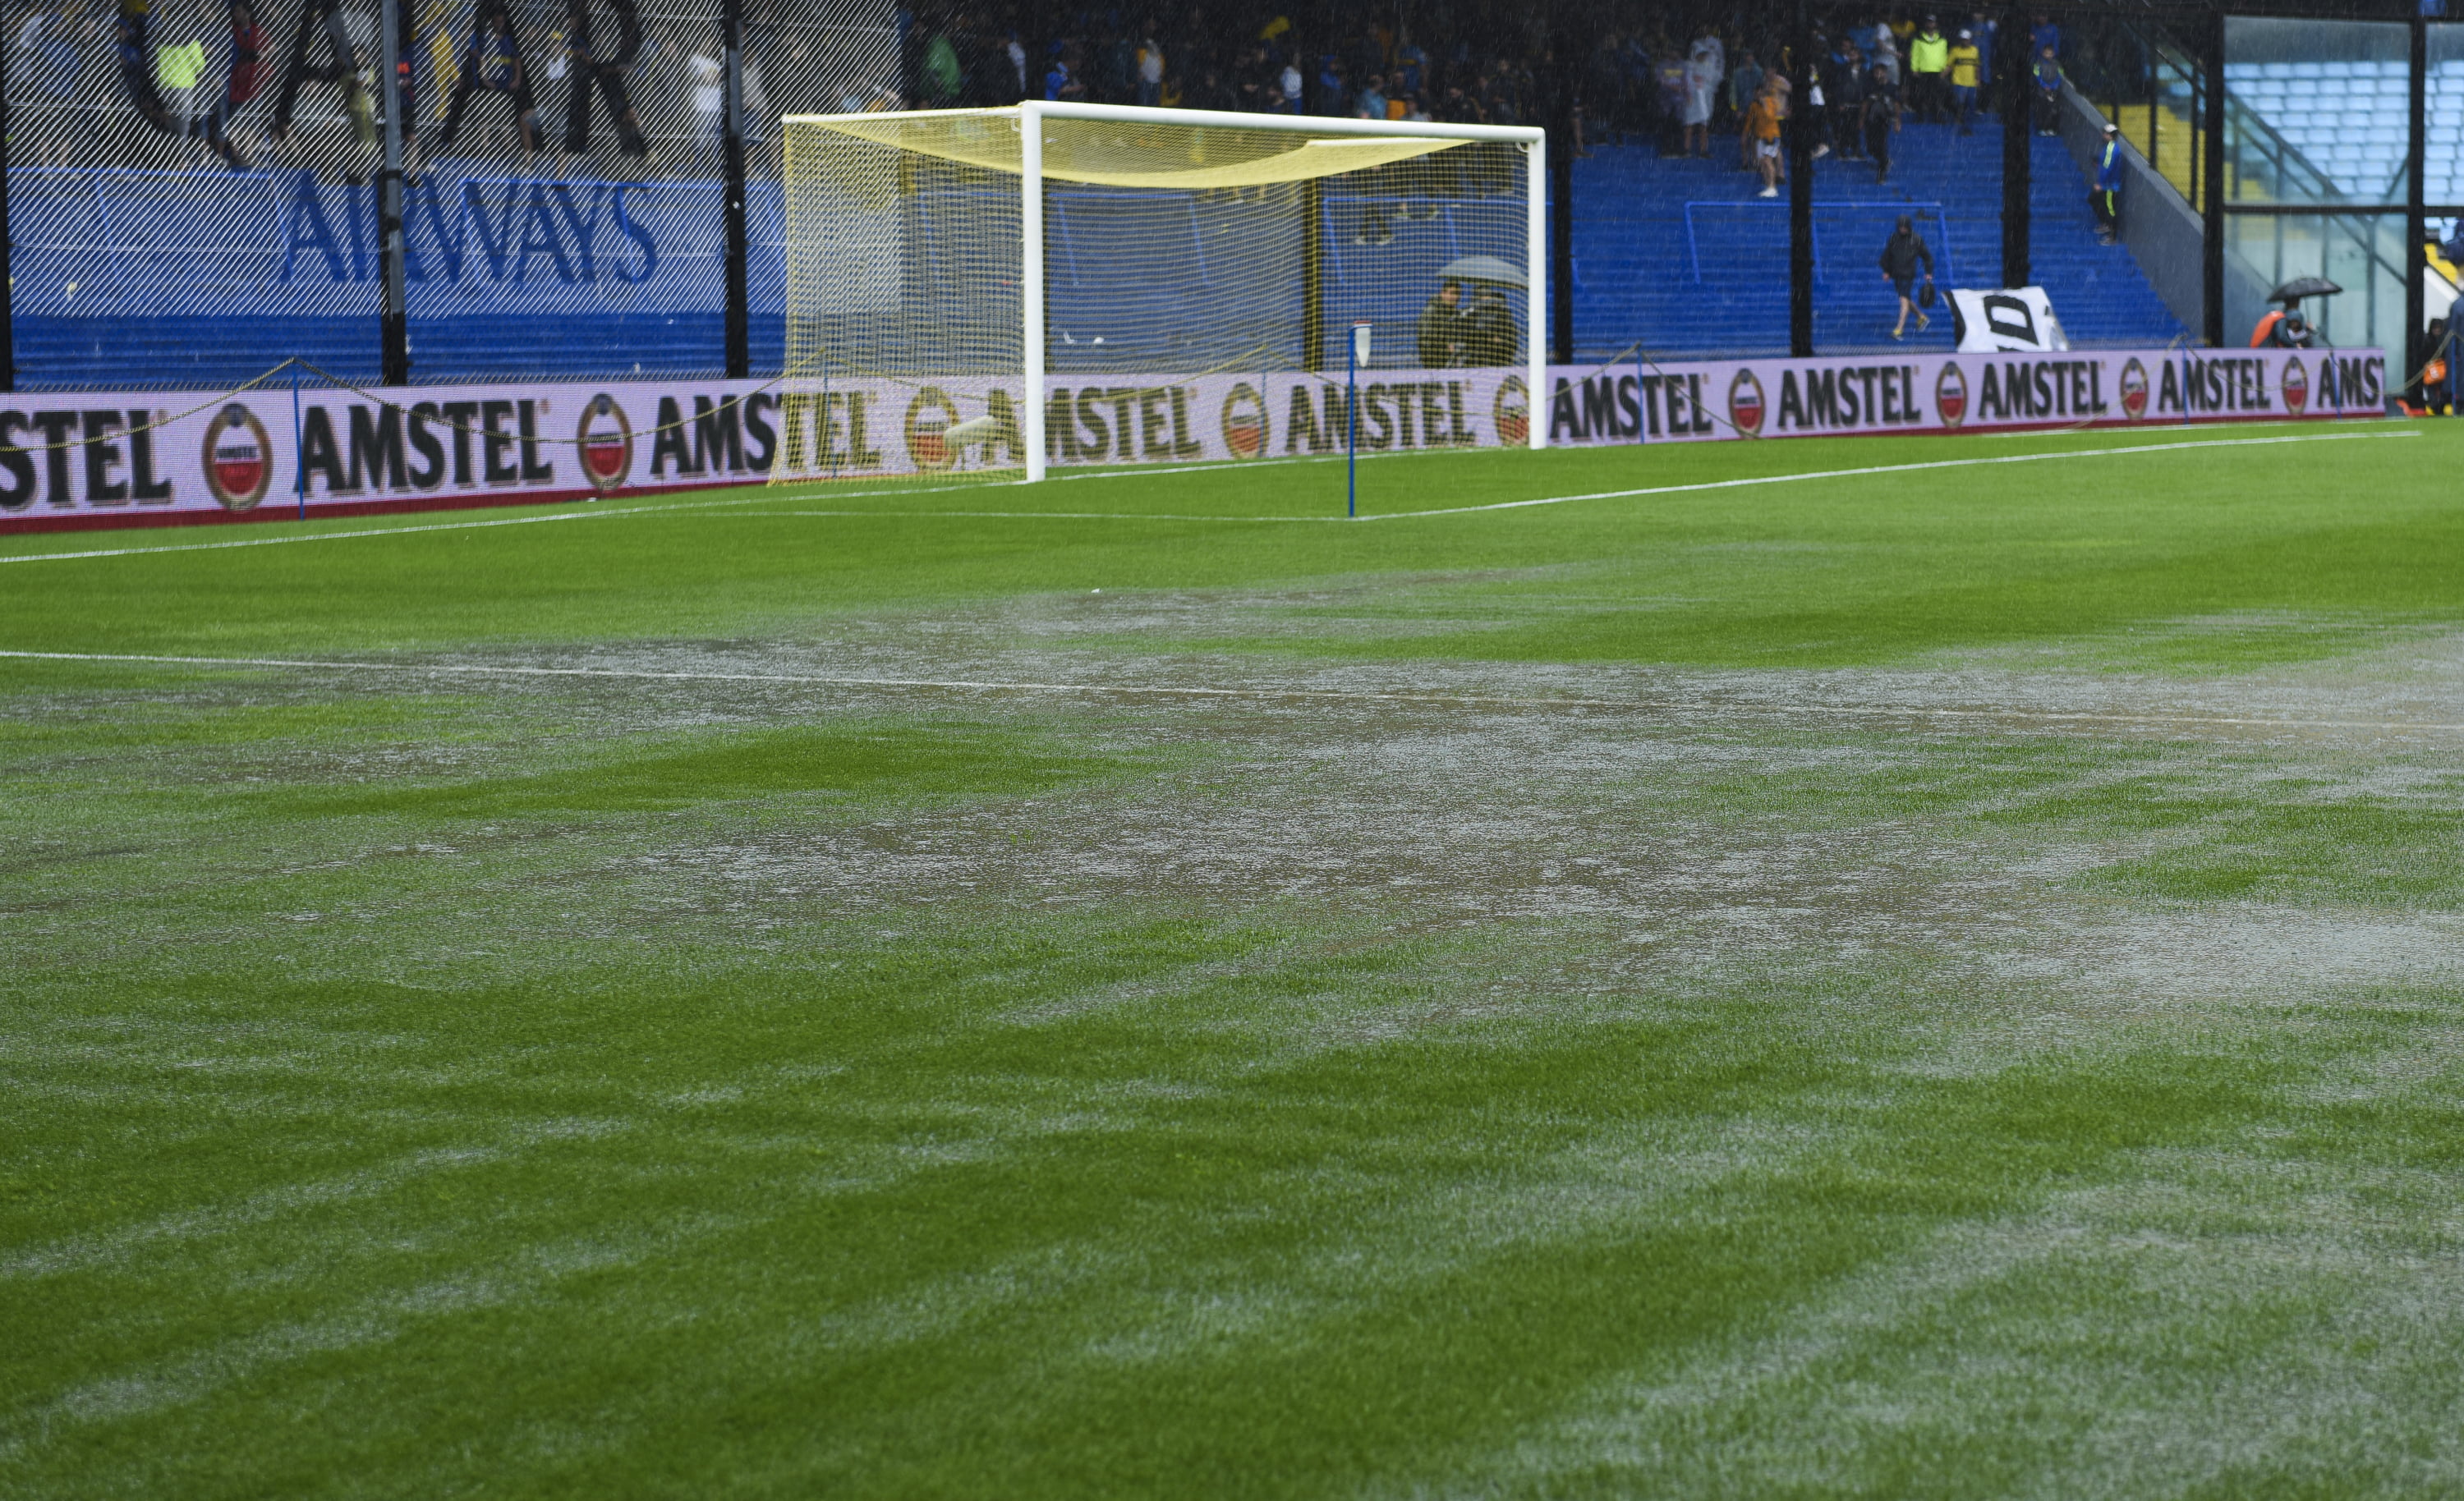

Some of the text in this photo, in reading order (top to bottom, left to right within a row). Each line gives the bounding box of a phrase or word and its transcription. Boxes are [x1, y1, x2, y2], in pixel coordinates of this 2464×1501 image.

[293, 398, 553, 494] AMSTEL
[650, 390, 882, 475] AMSTEL
[1285, 380, 1477, 452] AMSTEL
[1549, 373, 1713, 439] AMSTEL
[1777, 365, 1921, 428] AMSTEL
[1978, 360, 2108, 418] AMSTEL
[2157, 357, 2271, 411] AMSTEL
[2317, 356, 2384, 408] AMS
